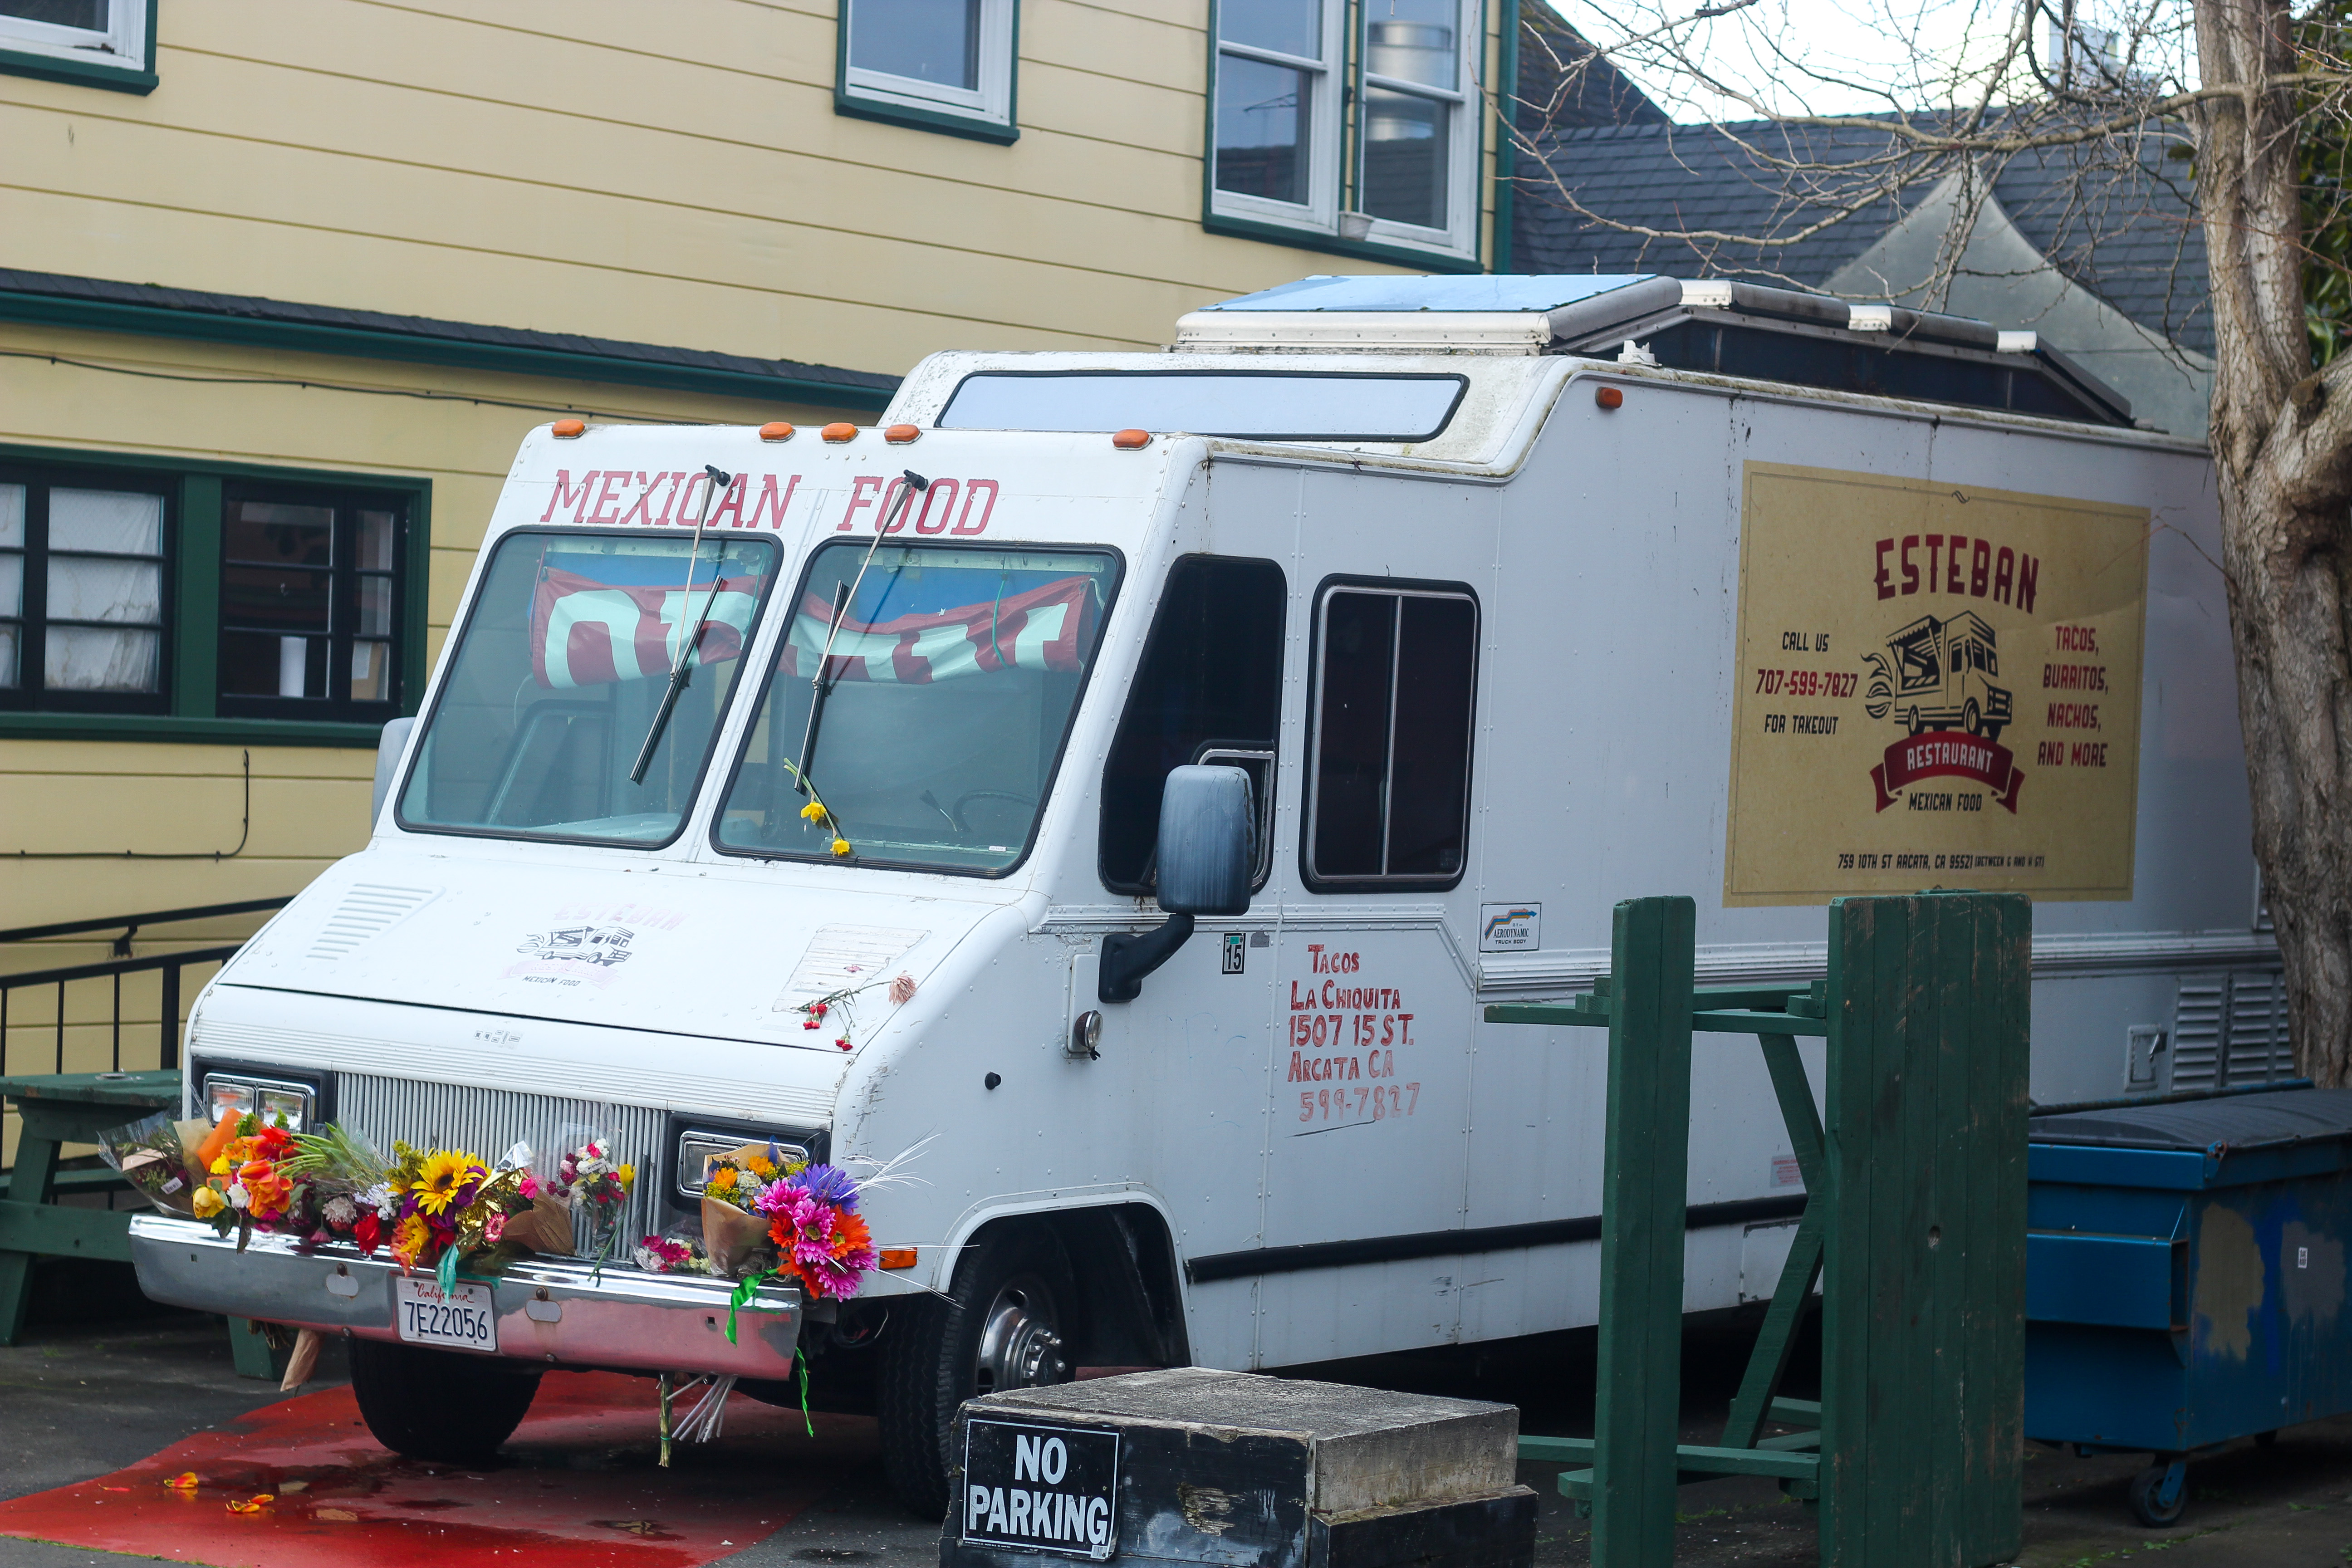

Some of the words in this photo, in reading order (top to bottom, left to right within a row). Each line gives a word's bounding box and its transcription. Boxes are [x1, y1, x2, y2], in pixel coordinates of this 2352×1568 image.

[540, 469, 802, 529] MEXICAN
[836, 475, 999, 535] FOOD
[1873, 534, 2039, 615] ESTEBAN
[1782, 631, 1809, 651] CALL
[1815, 633, 1830, 652] US
[2056, 625, 2099, 656] TACOS,
[1755, 669, 1858, 698] 707-599-7827
[2043, 663, 2109, 696] BURRITOS,
[1764, 714, 1786, 733] FOR
[1793, 715, 1839, 735] TAKEOUT
[2047, 703, 2102, 733] NACHOS,
[1907, 742, 1994, 773] RESTAURANT
[2037, 740, 2064, 766] AND
[2071, 741, 2108, 767] MORE
[1909, 793, 1953, 811] MEXICAN
[1957, 793, 1983, 811] FOOD
[1838, 853, 1854, 869] 759
[1858, 853, 1878, 869] 10TH
[1882, 854, 1893, 869] ST
[1896, 854, 1931, 872] ARCATA,
[1935, 854, 1946, 869] CA
[1950, 854, 1974, 869] 95521
[1493, 928, 1529, 938] AERODYNAMIC
[1226, 944, 1242, 970] 15
[1288, 1014, 1343, 1048] 1507
[1352, 1014, 1377, 1047] 15
[1368, 1049, 1395, 1079] CA
[1298, 1082, 1421, 1122] 599-7827
[417, 1283, 475, 1304] Califnia
[404, 1301, 488, 1340] 7E22056
[1014, 1434, 1068, 1485] NO
[969, 1485, 1108, 1545] PARKING
